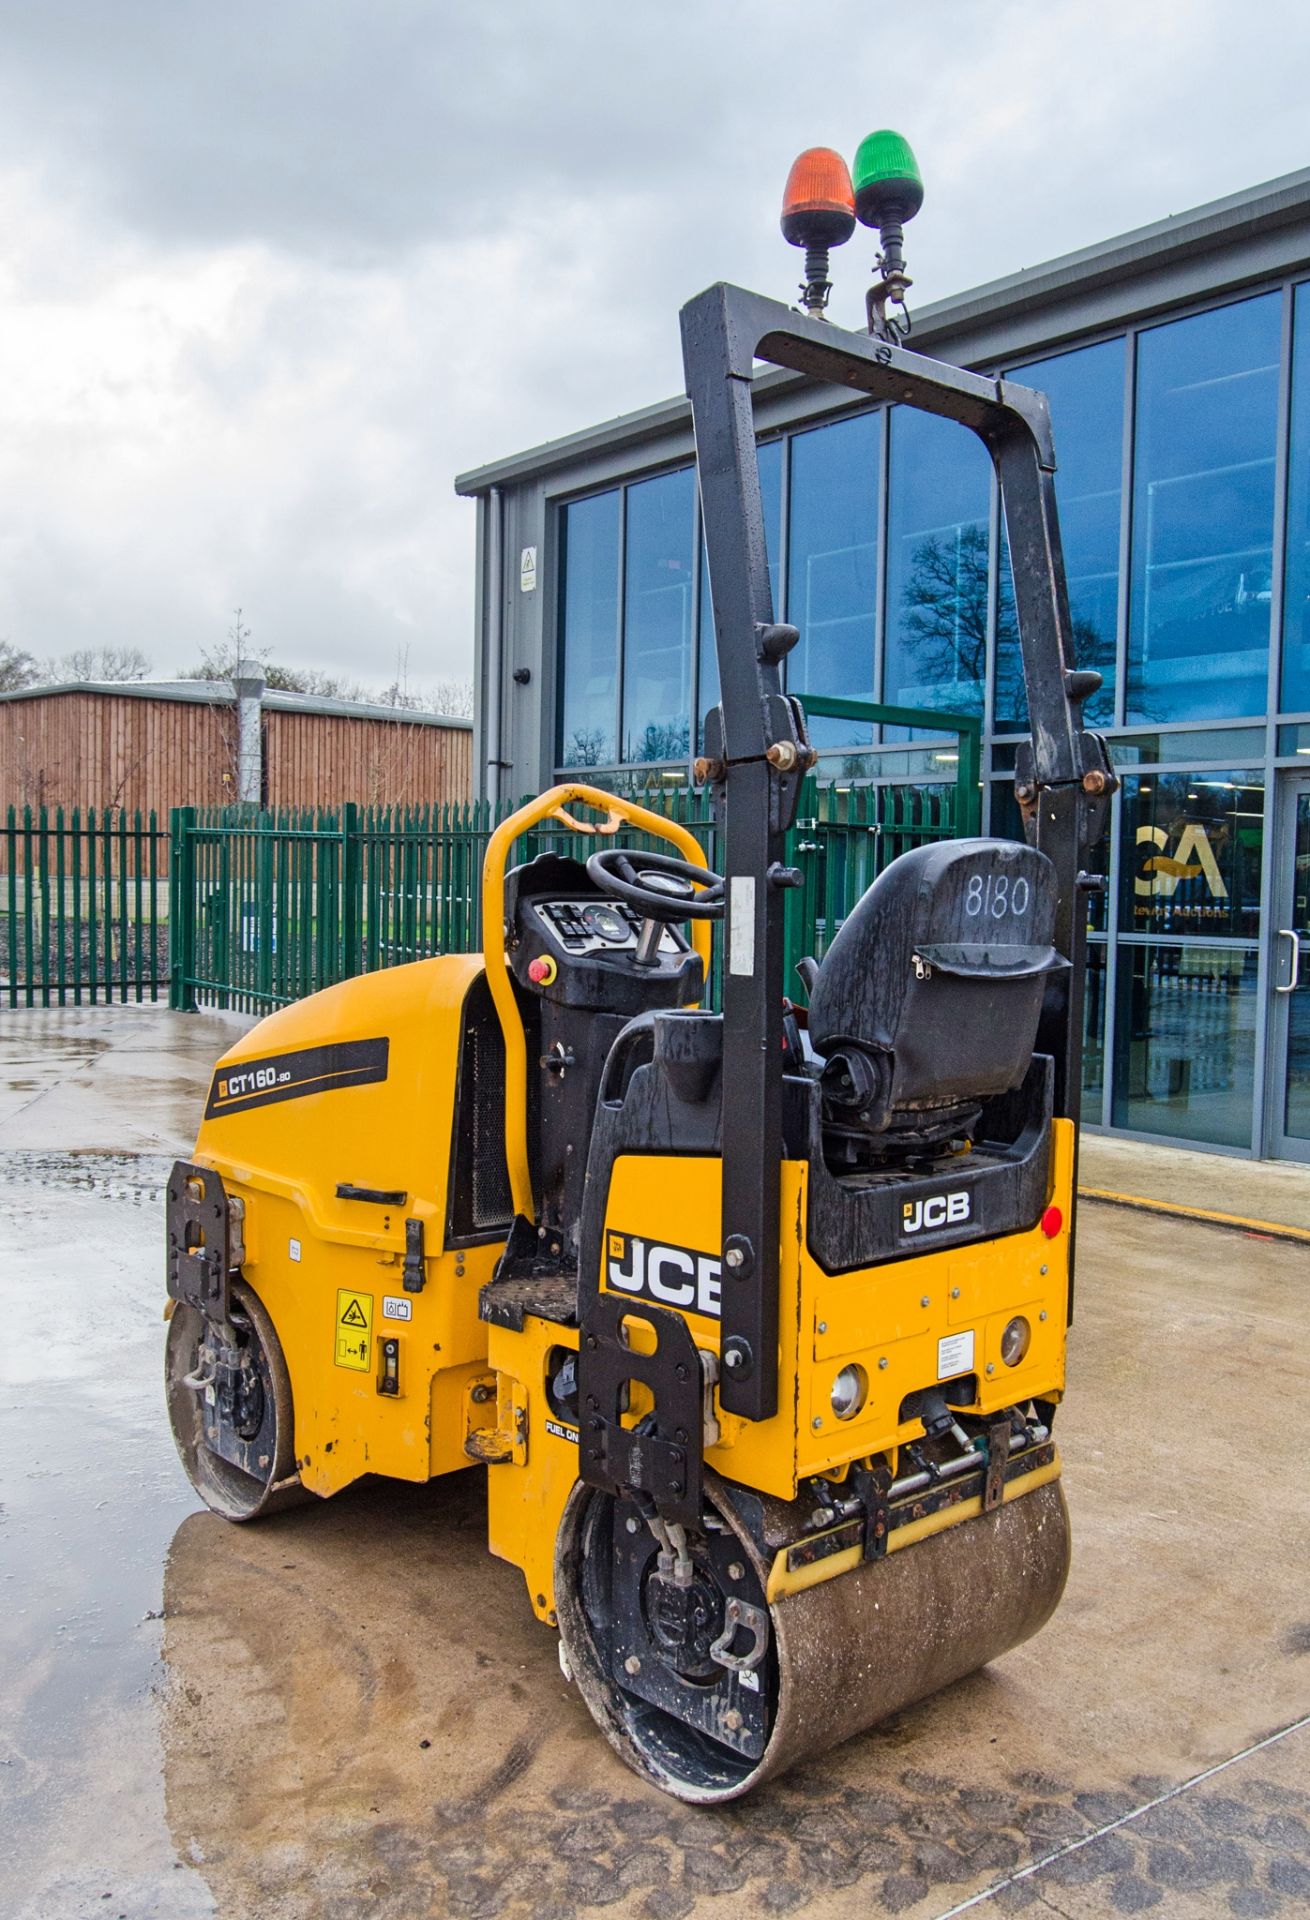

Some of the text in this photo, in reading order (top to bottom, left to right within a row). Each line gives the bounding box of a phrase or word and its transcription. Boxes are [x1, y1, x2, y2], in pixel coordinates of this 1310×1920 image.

[966, 875, 1029, 919] 8180
[903, 1191, 970, 1233] JCB
[546, 1421, 565, 1437] FUEL
